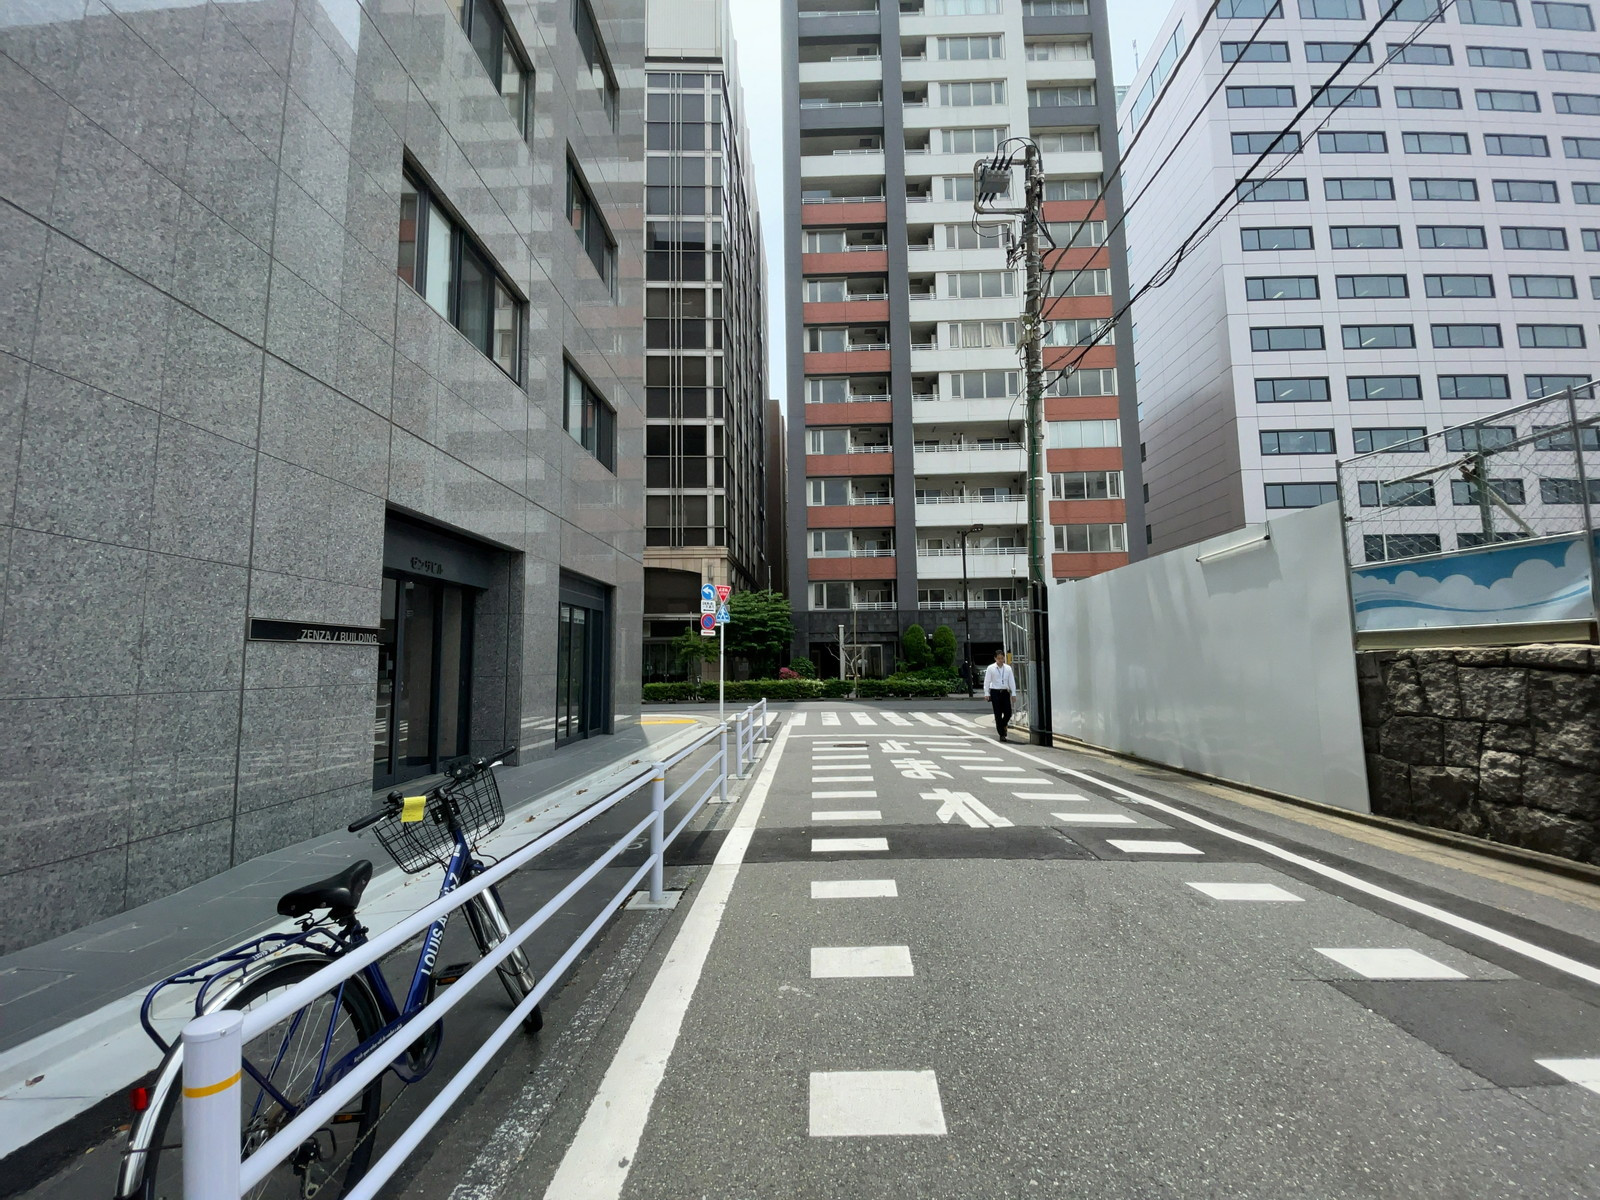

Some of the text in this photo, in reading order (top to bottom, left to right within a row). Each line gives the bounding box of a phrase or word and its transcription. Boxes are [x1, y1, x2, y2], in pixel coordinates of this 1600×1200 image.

[411, 556, 443, 575] ゼンザビル
[301, 629, 331, 641] ZENZA
[340, 631, 378, 643] BUILDING
[879, 740, 1015, 828] 止まれ
[421, 927, 443, 976] LOUIS
